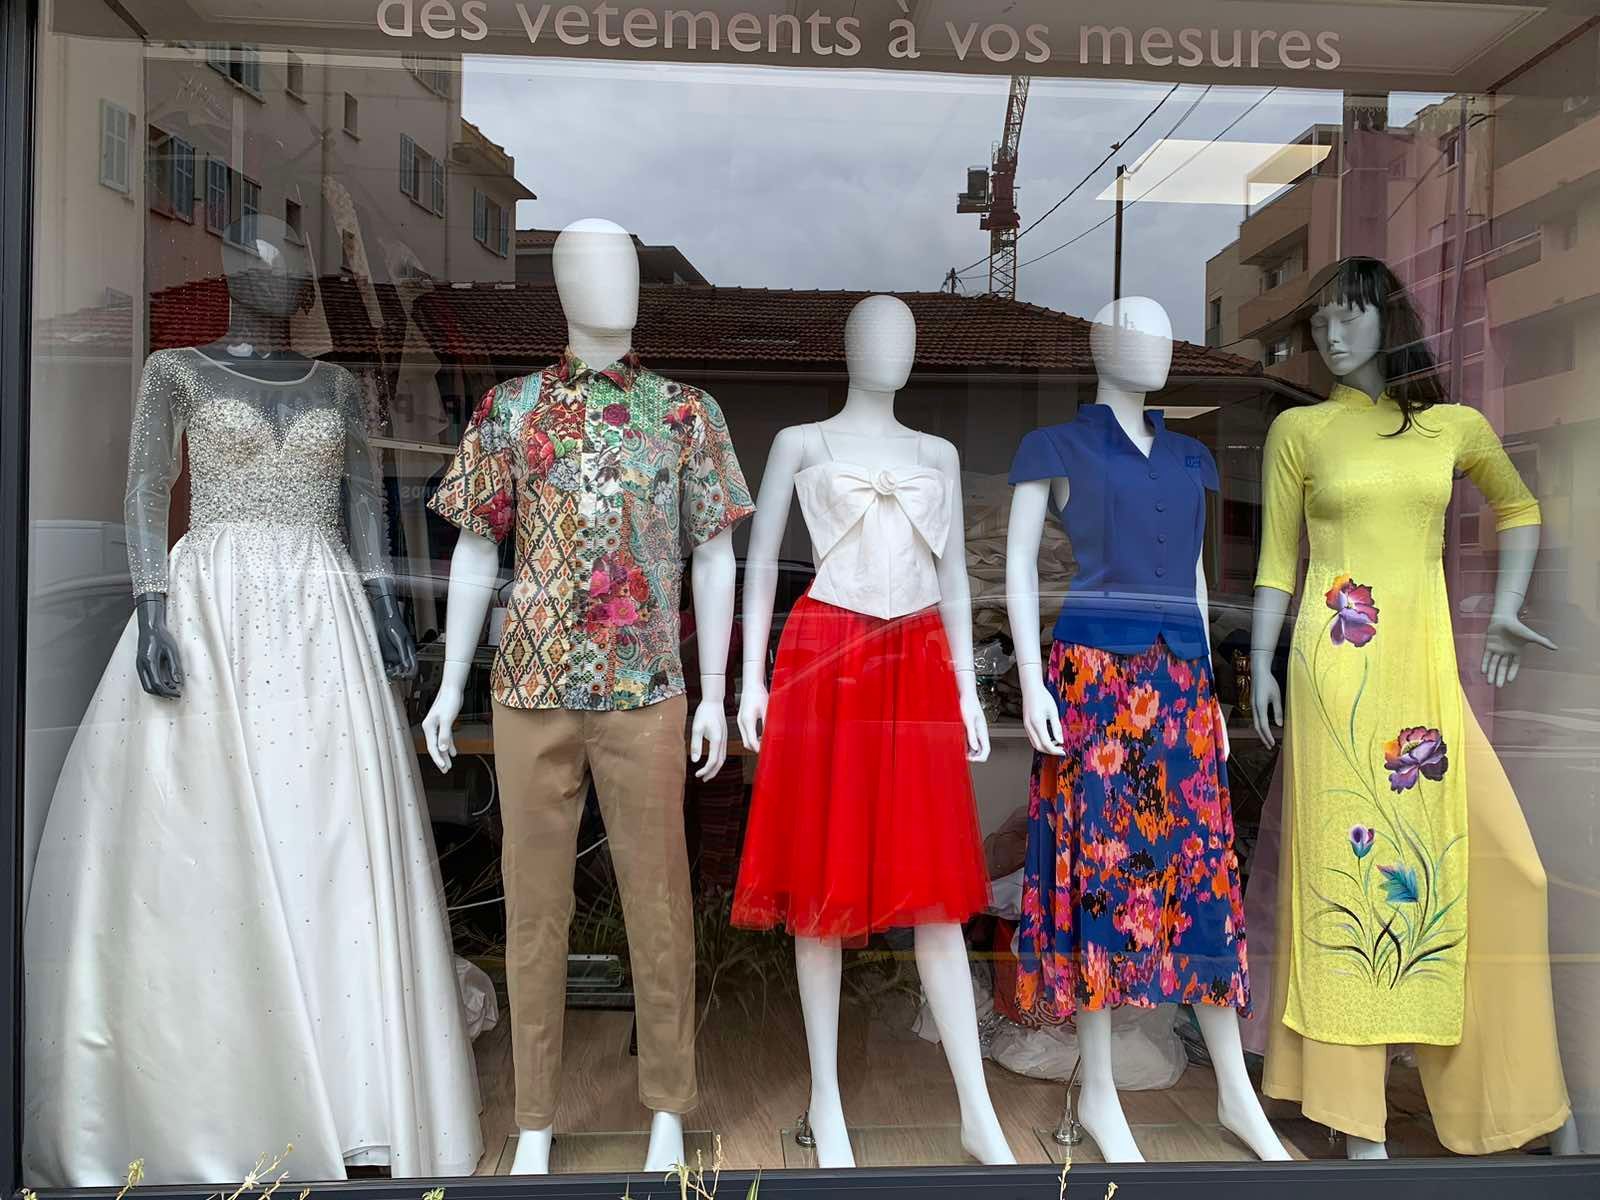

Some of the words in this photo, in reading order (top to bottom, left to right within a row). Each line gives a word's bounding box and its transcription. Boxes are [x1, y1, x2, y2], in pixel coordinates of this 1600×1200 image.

[376, 0, 489, 41] des
[887, 0, 921, 59] à
[945, 20, 1051, 63] vos
[1078, 23, 1342, 71] mesures
